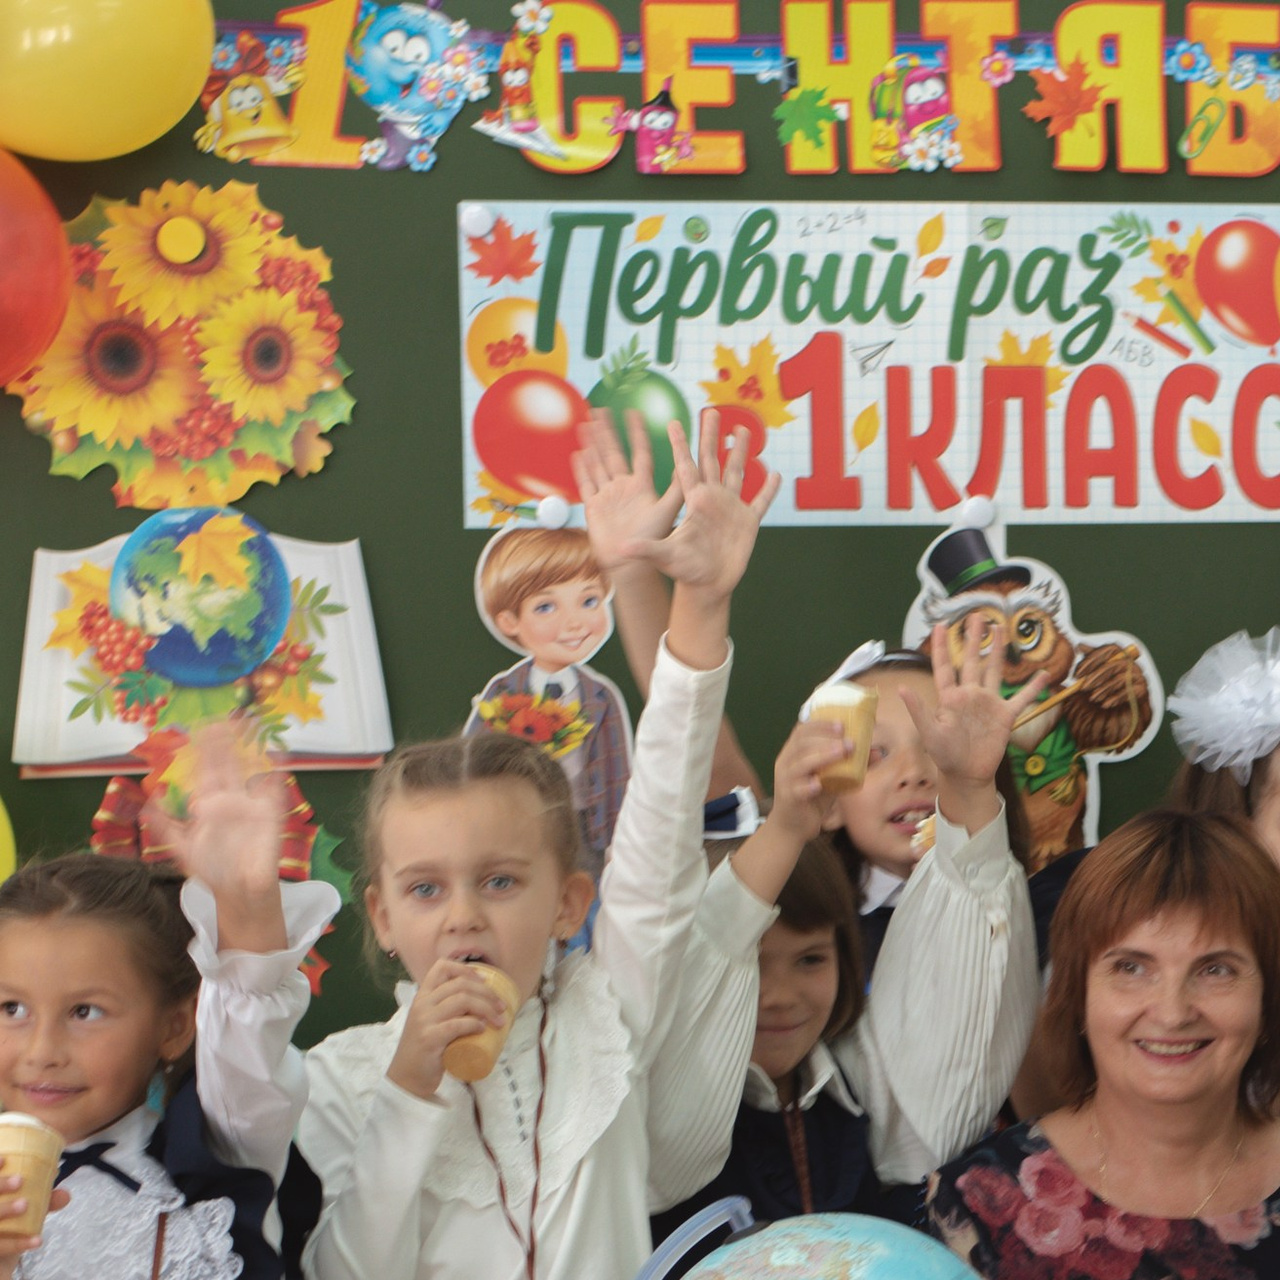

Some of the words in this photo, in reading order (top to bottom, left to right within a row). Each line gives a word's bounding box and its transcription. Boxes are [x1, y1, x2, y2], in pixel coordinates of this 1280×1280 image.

[251, 0, 368, 170] 1
[534, 206, 925, 364] Первый
[947, 233, 1122, 365] раз
[1108, 335, 1155, 368] АБВ
[777, 331, 862, 511] 1
